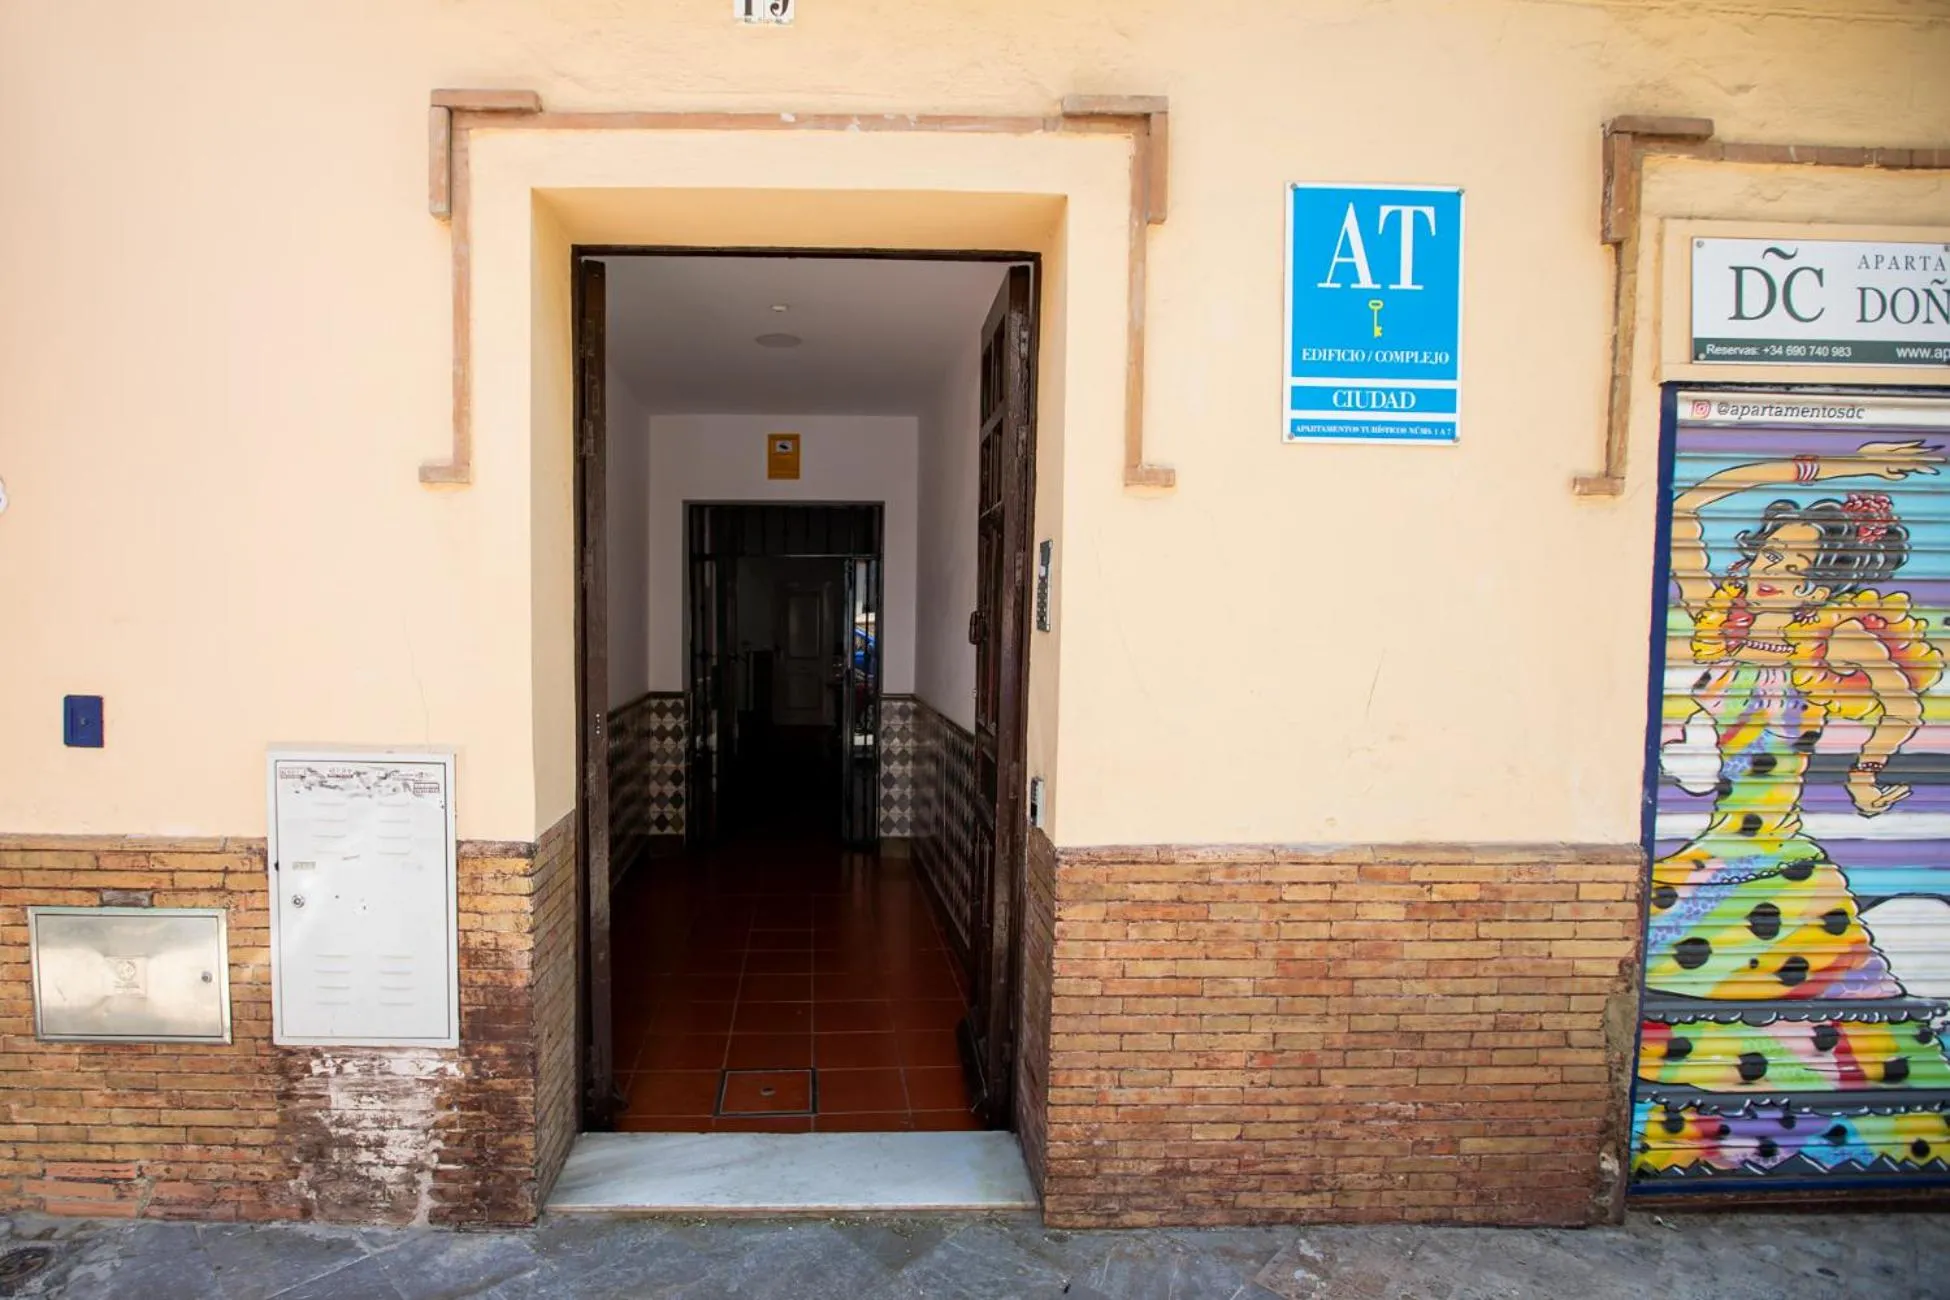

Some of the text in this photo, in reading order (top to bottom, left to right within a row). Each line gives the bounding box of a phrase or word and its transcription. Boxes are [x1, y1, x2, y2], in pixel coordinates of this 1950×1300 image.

[1316, 200, 1436, 290] AT
[1857, 254, 1946, 271] APARTA
[1856, 278, 1950, 325] DOÑ
[1301, 347, 1366, 362] EDIFICIO
[1374, 350, 1450, 365] COMPLEJO
[1705, 343, 1760, 357] Reservas:
[1763, 345, 1783, 356] +34
[1785, 345, 1806, 357] 690
[1809, 345, 1829, 357] 740
[1832, 346, 1852, 357] 983
[1332, 389, 1417, 409] CIUDAD
[1716, 401, 1866, 420] @apartamentosdc
